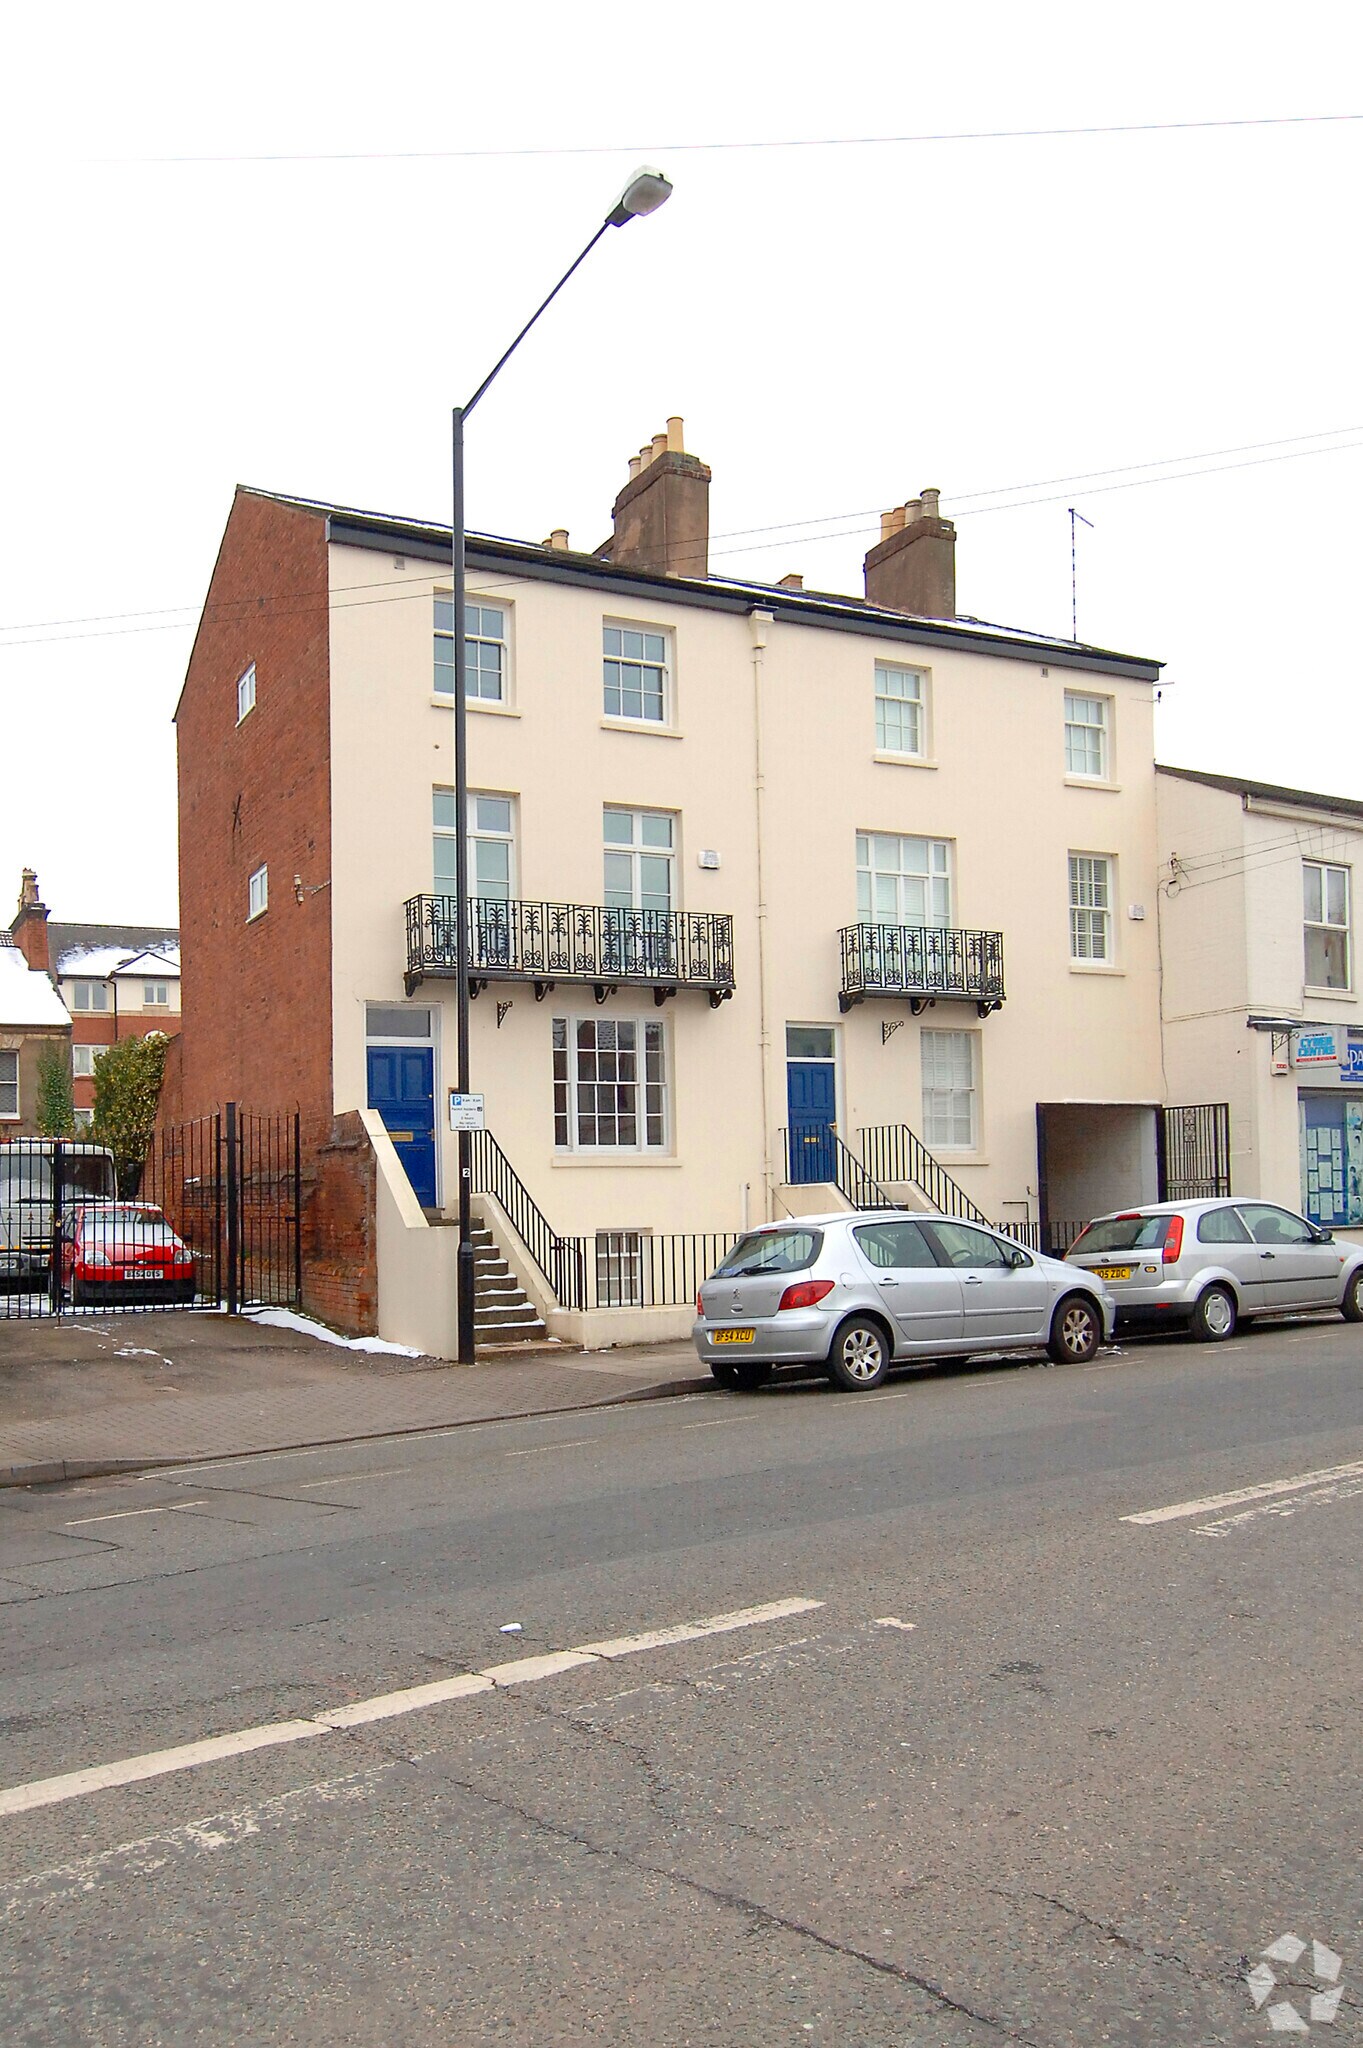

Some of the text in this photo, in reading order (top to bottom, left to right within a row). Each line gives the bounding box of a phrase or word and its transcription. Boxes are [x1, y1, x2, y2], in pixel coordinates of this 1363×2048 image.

[1301, 1037, 1332, 1047] CYBER
[1298, 1045, 1335, 1056] CENTRE
[454, 1096, 460, 1105] P
[735, 1330, 751, 1341] XCU
